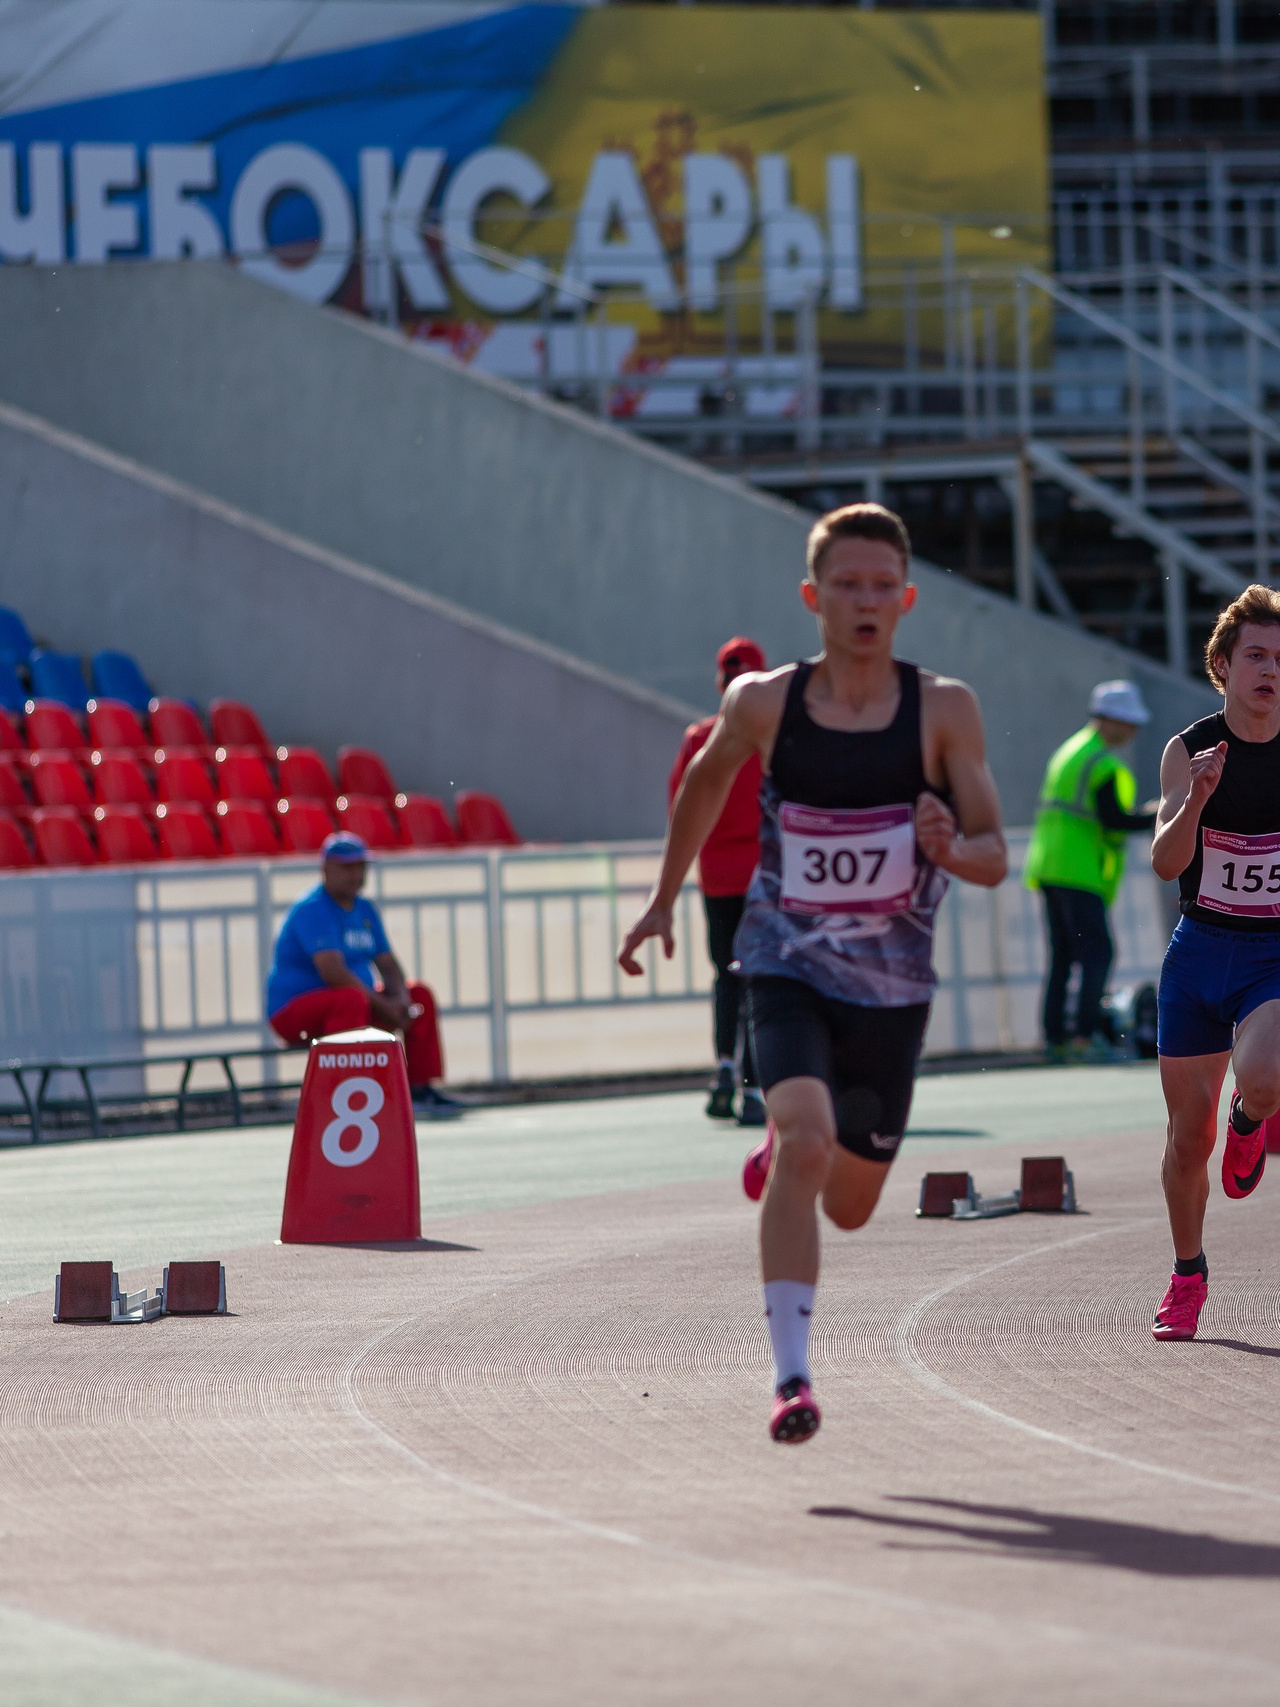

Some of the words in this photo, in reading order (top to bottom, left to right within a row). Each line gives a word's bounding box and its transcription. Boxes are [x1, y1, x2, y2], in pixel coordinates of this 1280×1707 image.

[0, 142, 862, 312] ЧЕБОКСАРЫ
[1209, 834, 1247, 846] ПЕРВЕНСТВО
[803, 848, 888, 885] 307
[1194, 923, 1228, 940] HIGH
[318, 1053, 389, 1069] MONDO
[321, 1076, 385, 1168] 8
